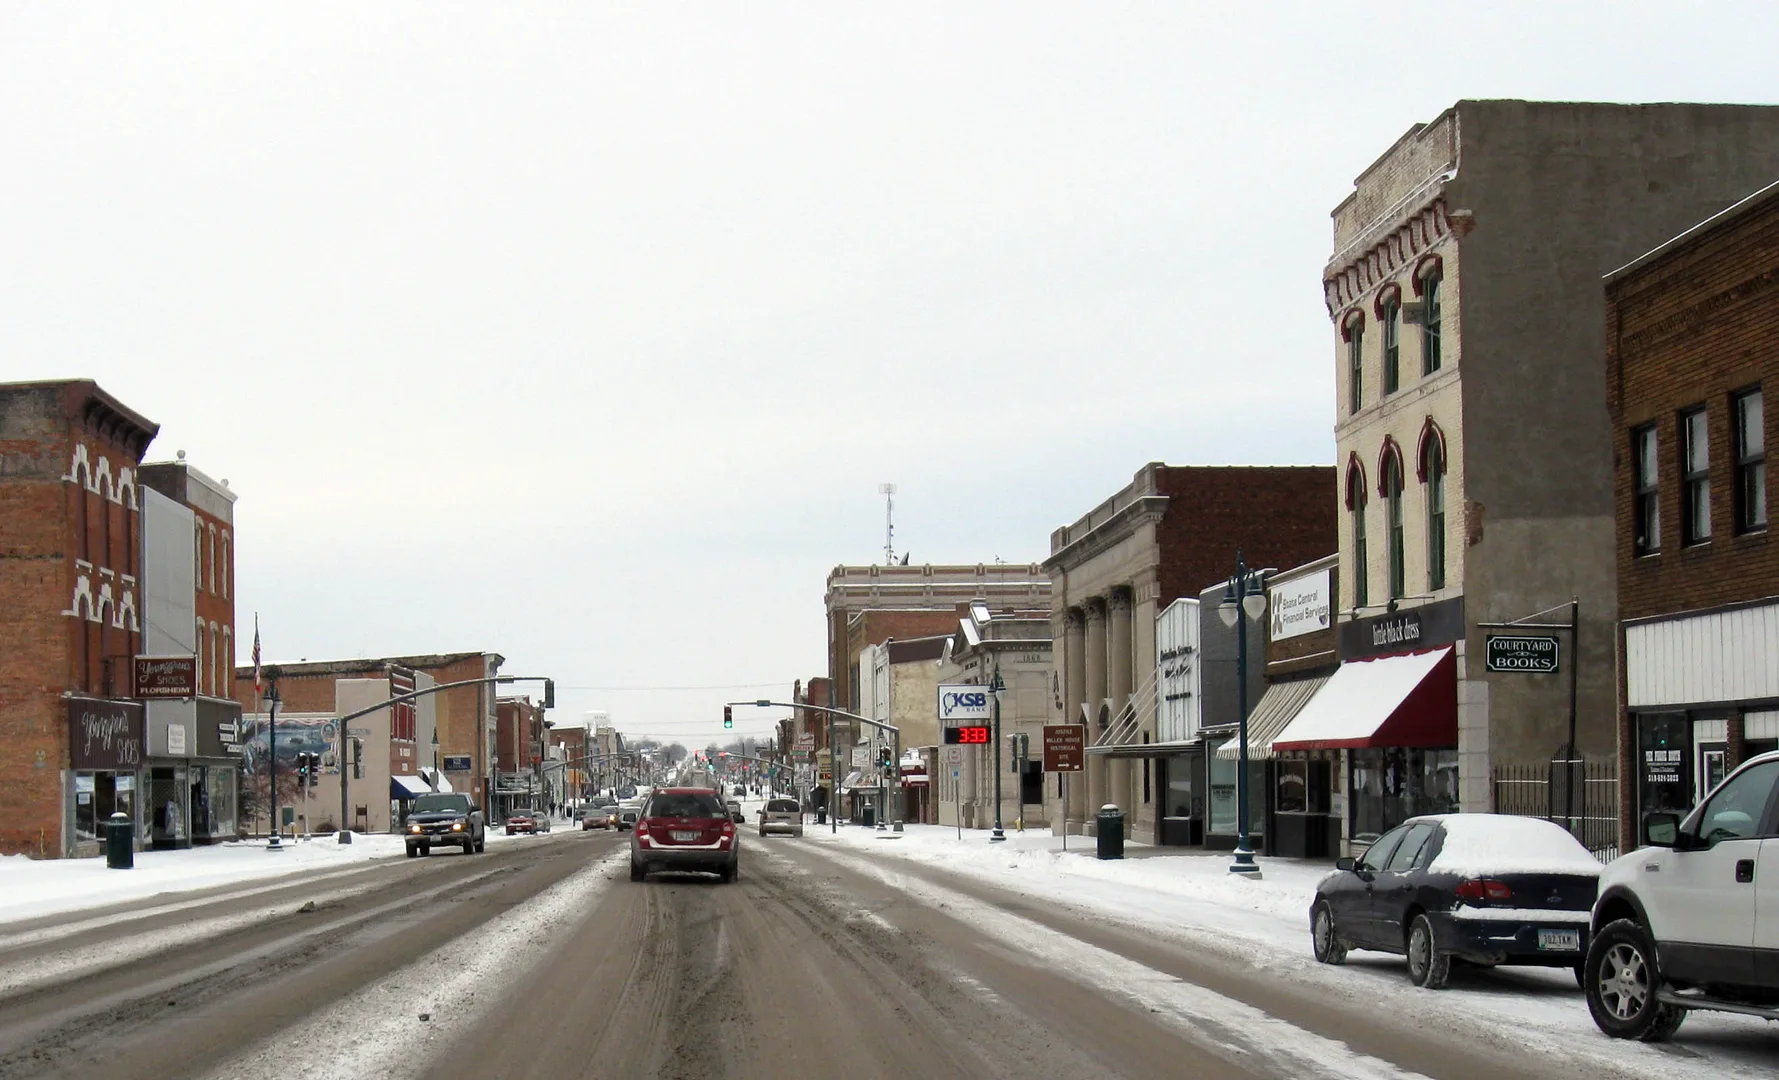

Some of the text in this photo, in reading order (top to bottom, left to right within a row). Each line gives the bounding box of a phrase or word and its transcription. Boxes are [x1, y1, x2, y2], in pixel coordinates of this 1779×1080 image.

[1283, 590, 1318, 609] State Central
[1283, 605, 1328, 624] Financial Services
[1373, 618, 1419, 645] little black dress
[1494, 640, 1552, 651] COURTYARD
[1496, 657, 1551, 668] BOOKS
[157, 675, 186, 685] SHOES
[953, 692, 986, 706] KSB
[959, 727, 987, 743] 3:33
[117, 738, 140, 764] SHOES
